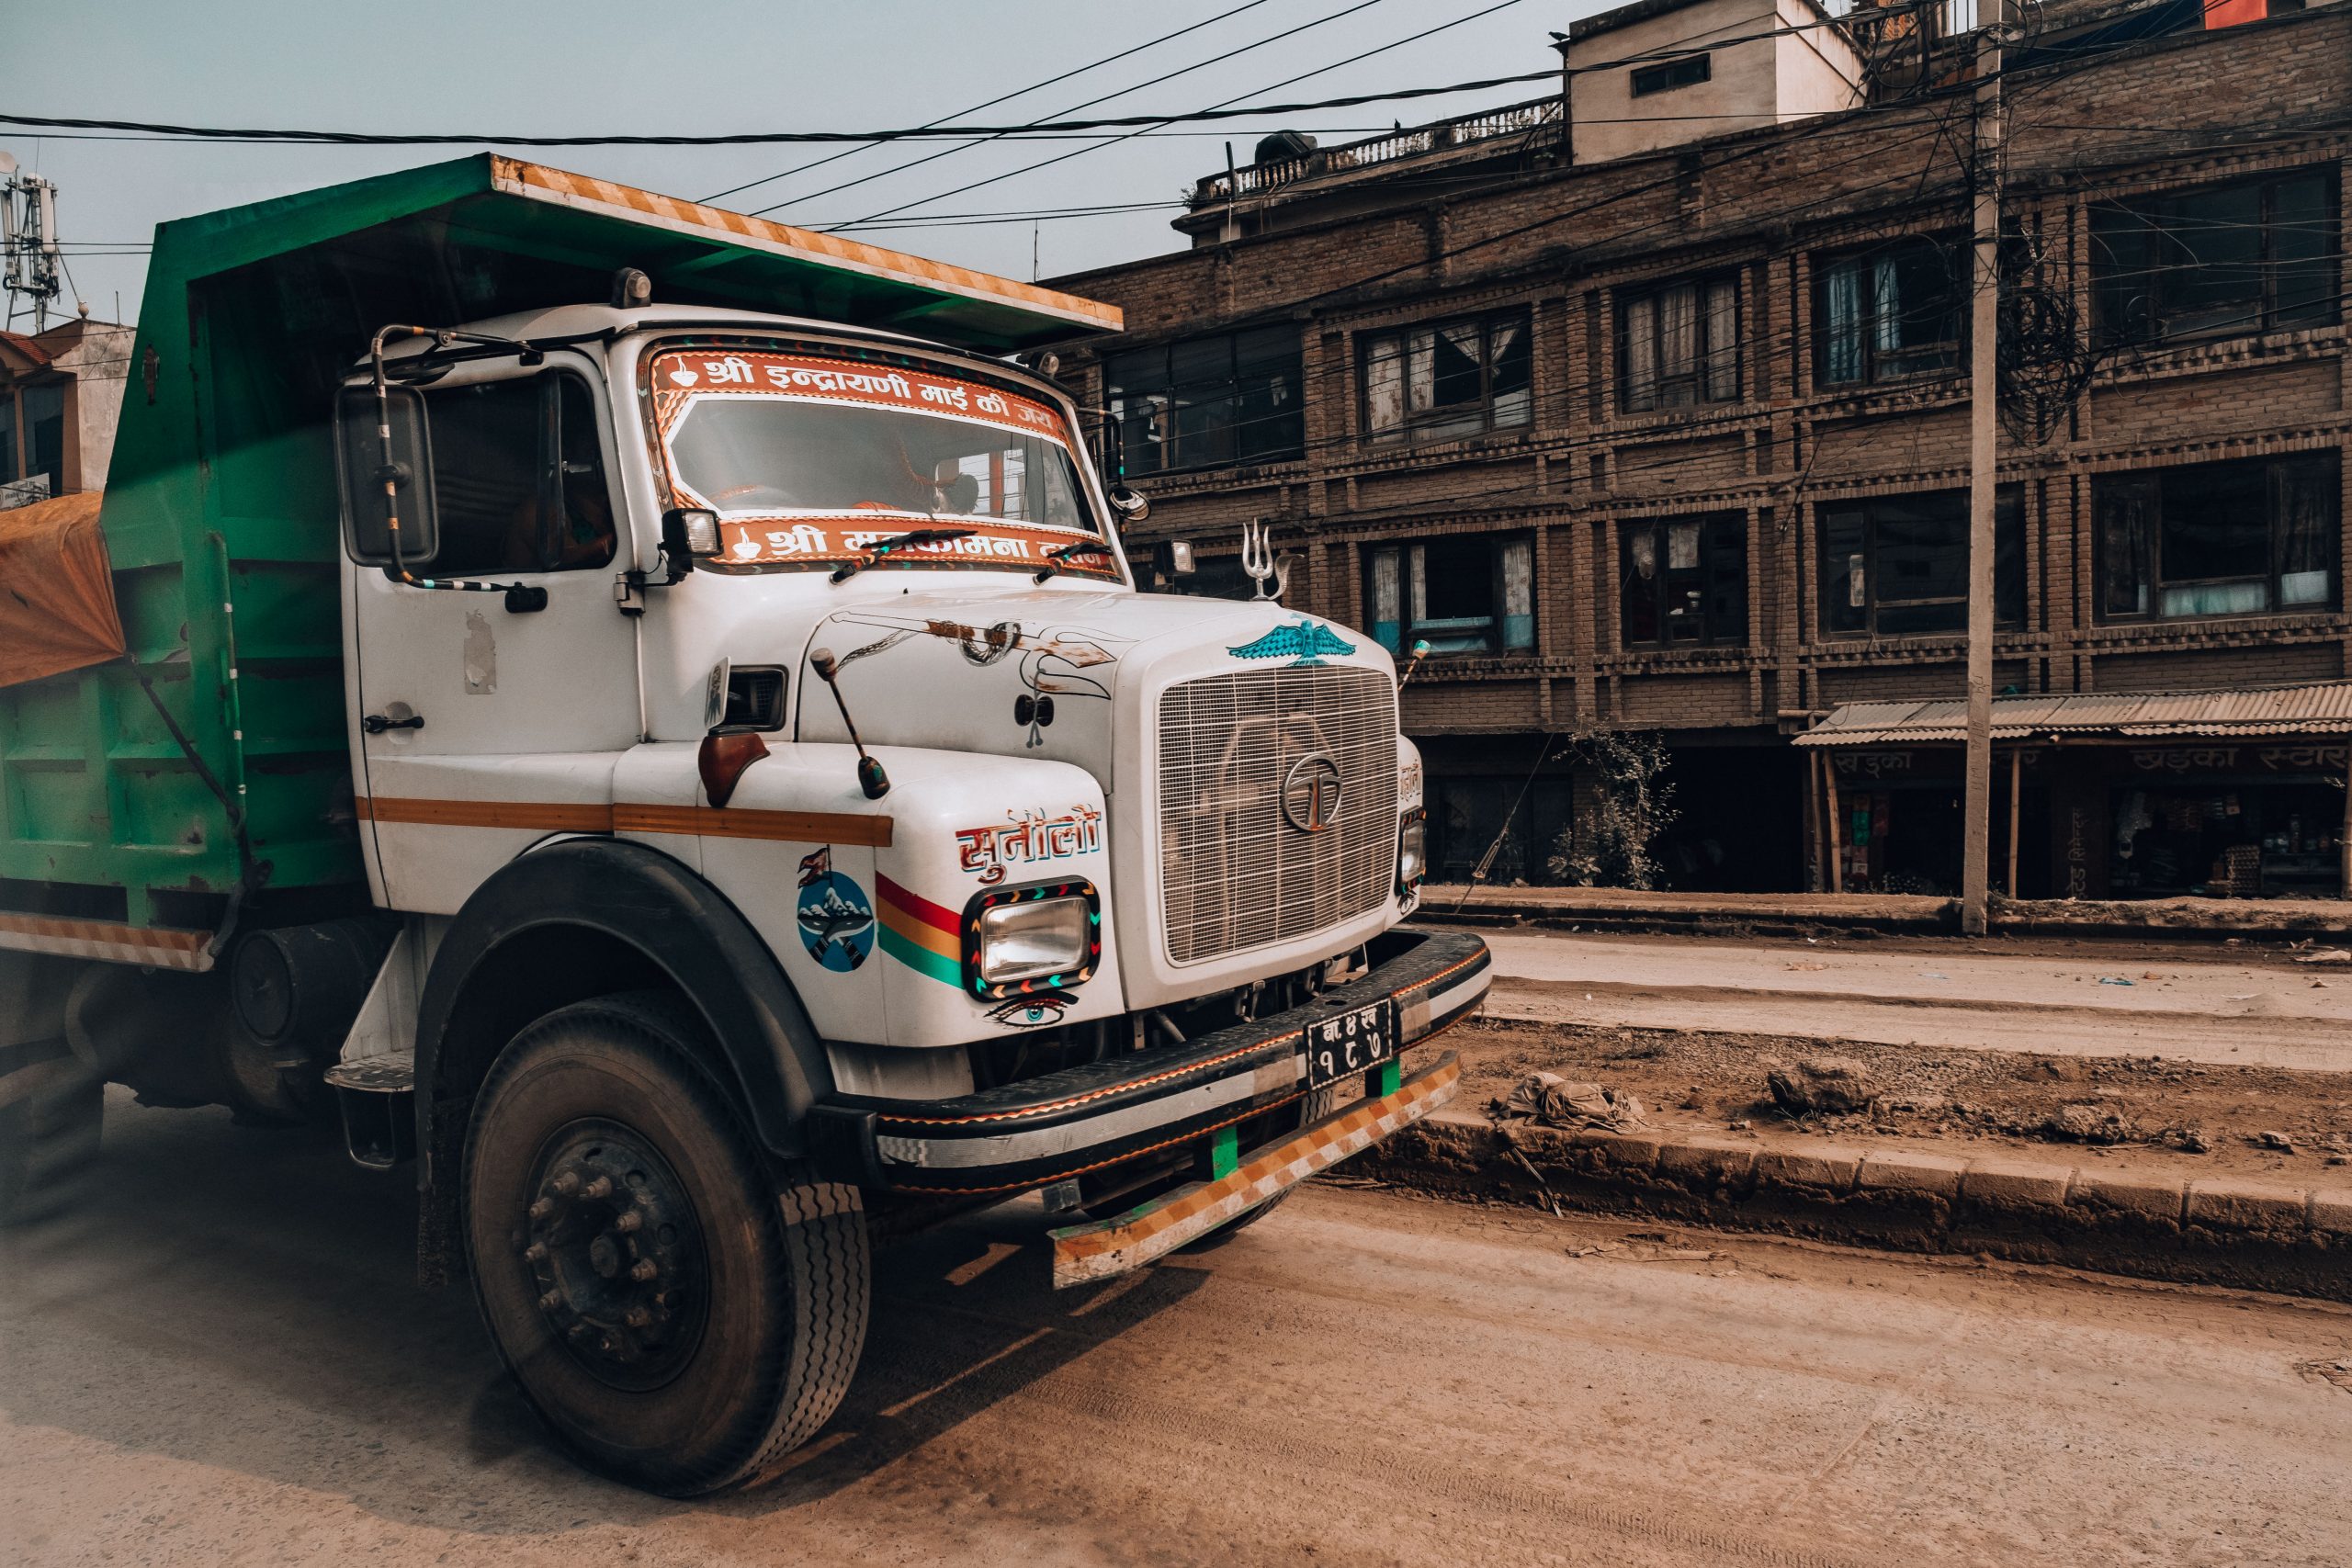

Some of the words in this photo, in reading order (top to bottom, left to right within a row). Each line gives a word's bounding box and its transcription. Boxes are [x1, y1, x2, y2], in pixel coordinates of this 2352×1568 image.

[704, 356, 755, 383] श्री
[764, 365, 912, 399] इन्द्रायणी
[917, 383, 968, 411] माई
[974, 393, 1010, 417] की
[1014, 403, 1054, 429] जय
[765, 525, 828, 555] श्री
